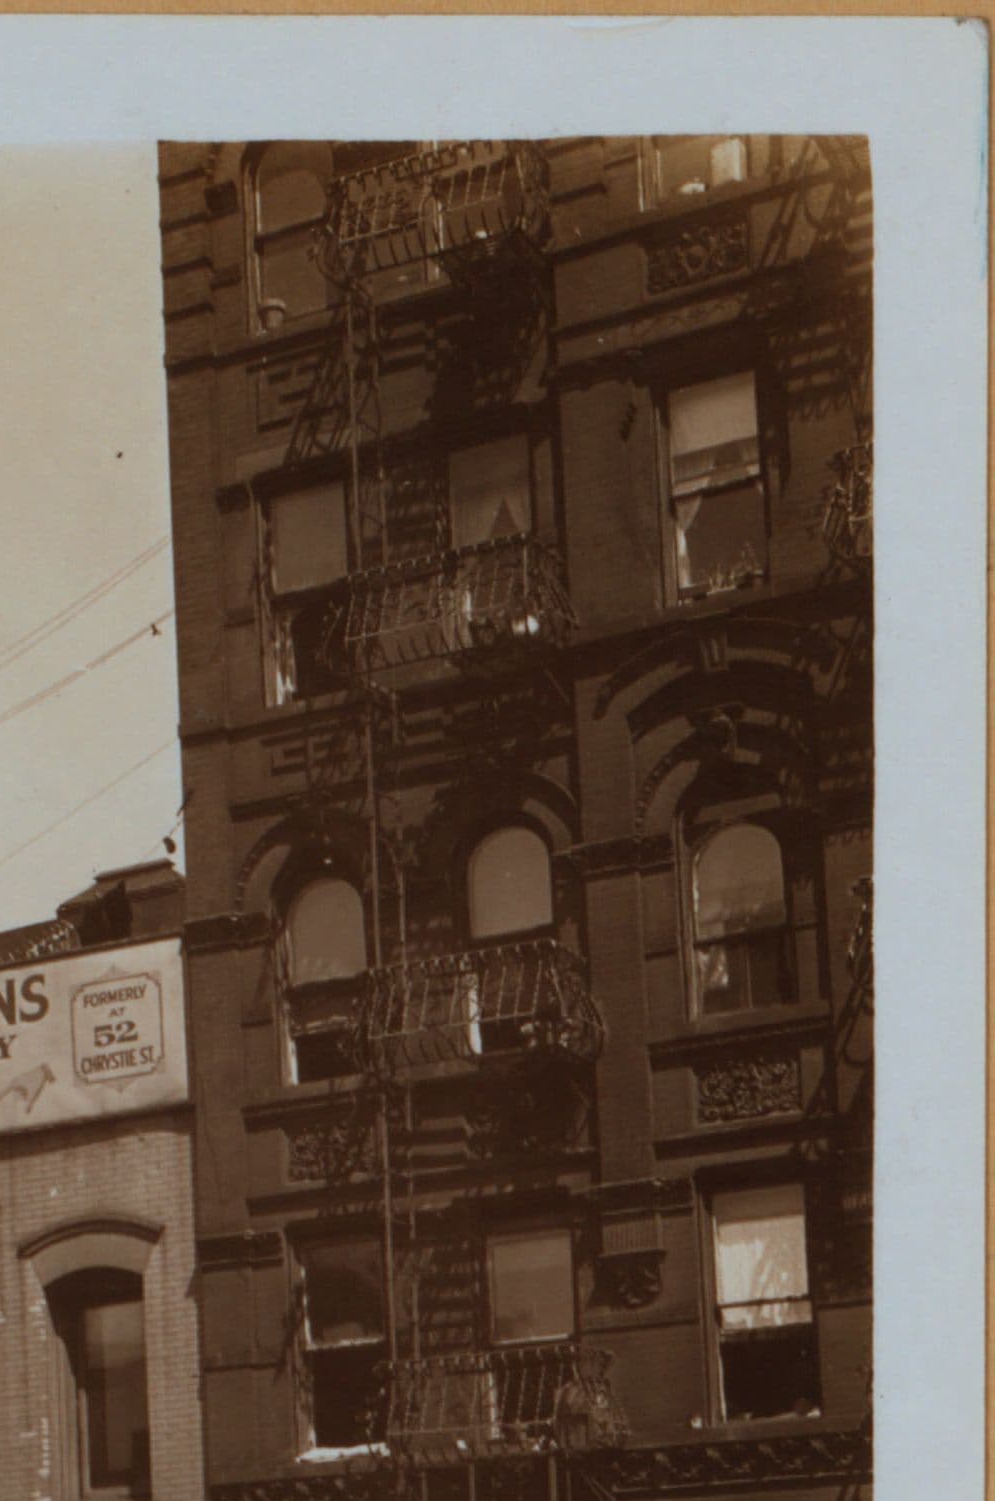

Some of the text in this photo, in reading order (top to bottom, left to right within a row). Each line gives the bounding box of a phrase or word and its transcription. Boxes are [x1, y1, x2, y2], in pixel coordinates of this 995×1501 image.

[83, 984, 147, 1008] FORMERLY
[108, 1007, 125, 1018] AT
[93, 1020, 139, 1048] 52
[81, 1048, 136, 1075] CHRYSTIE
